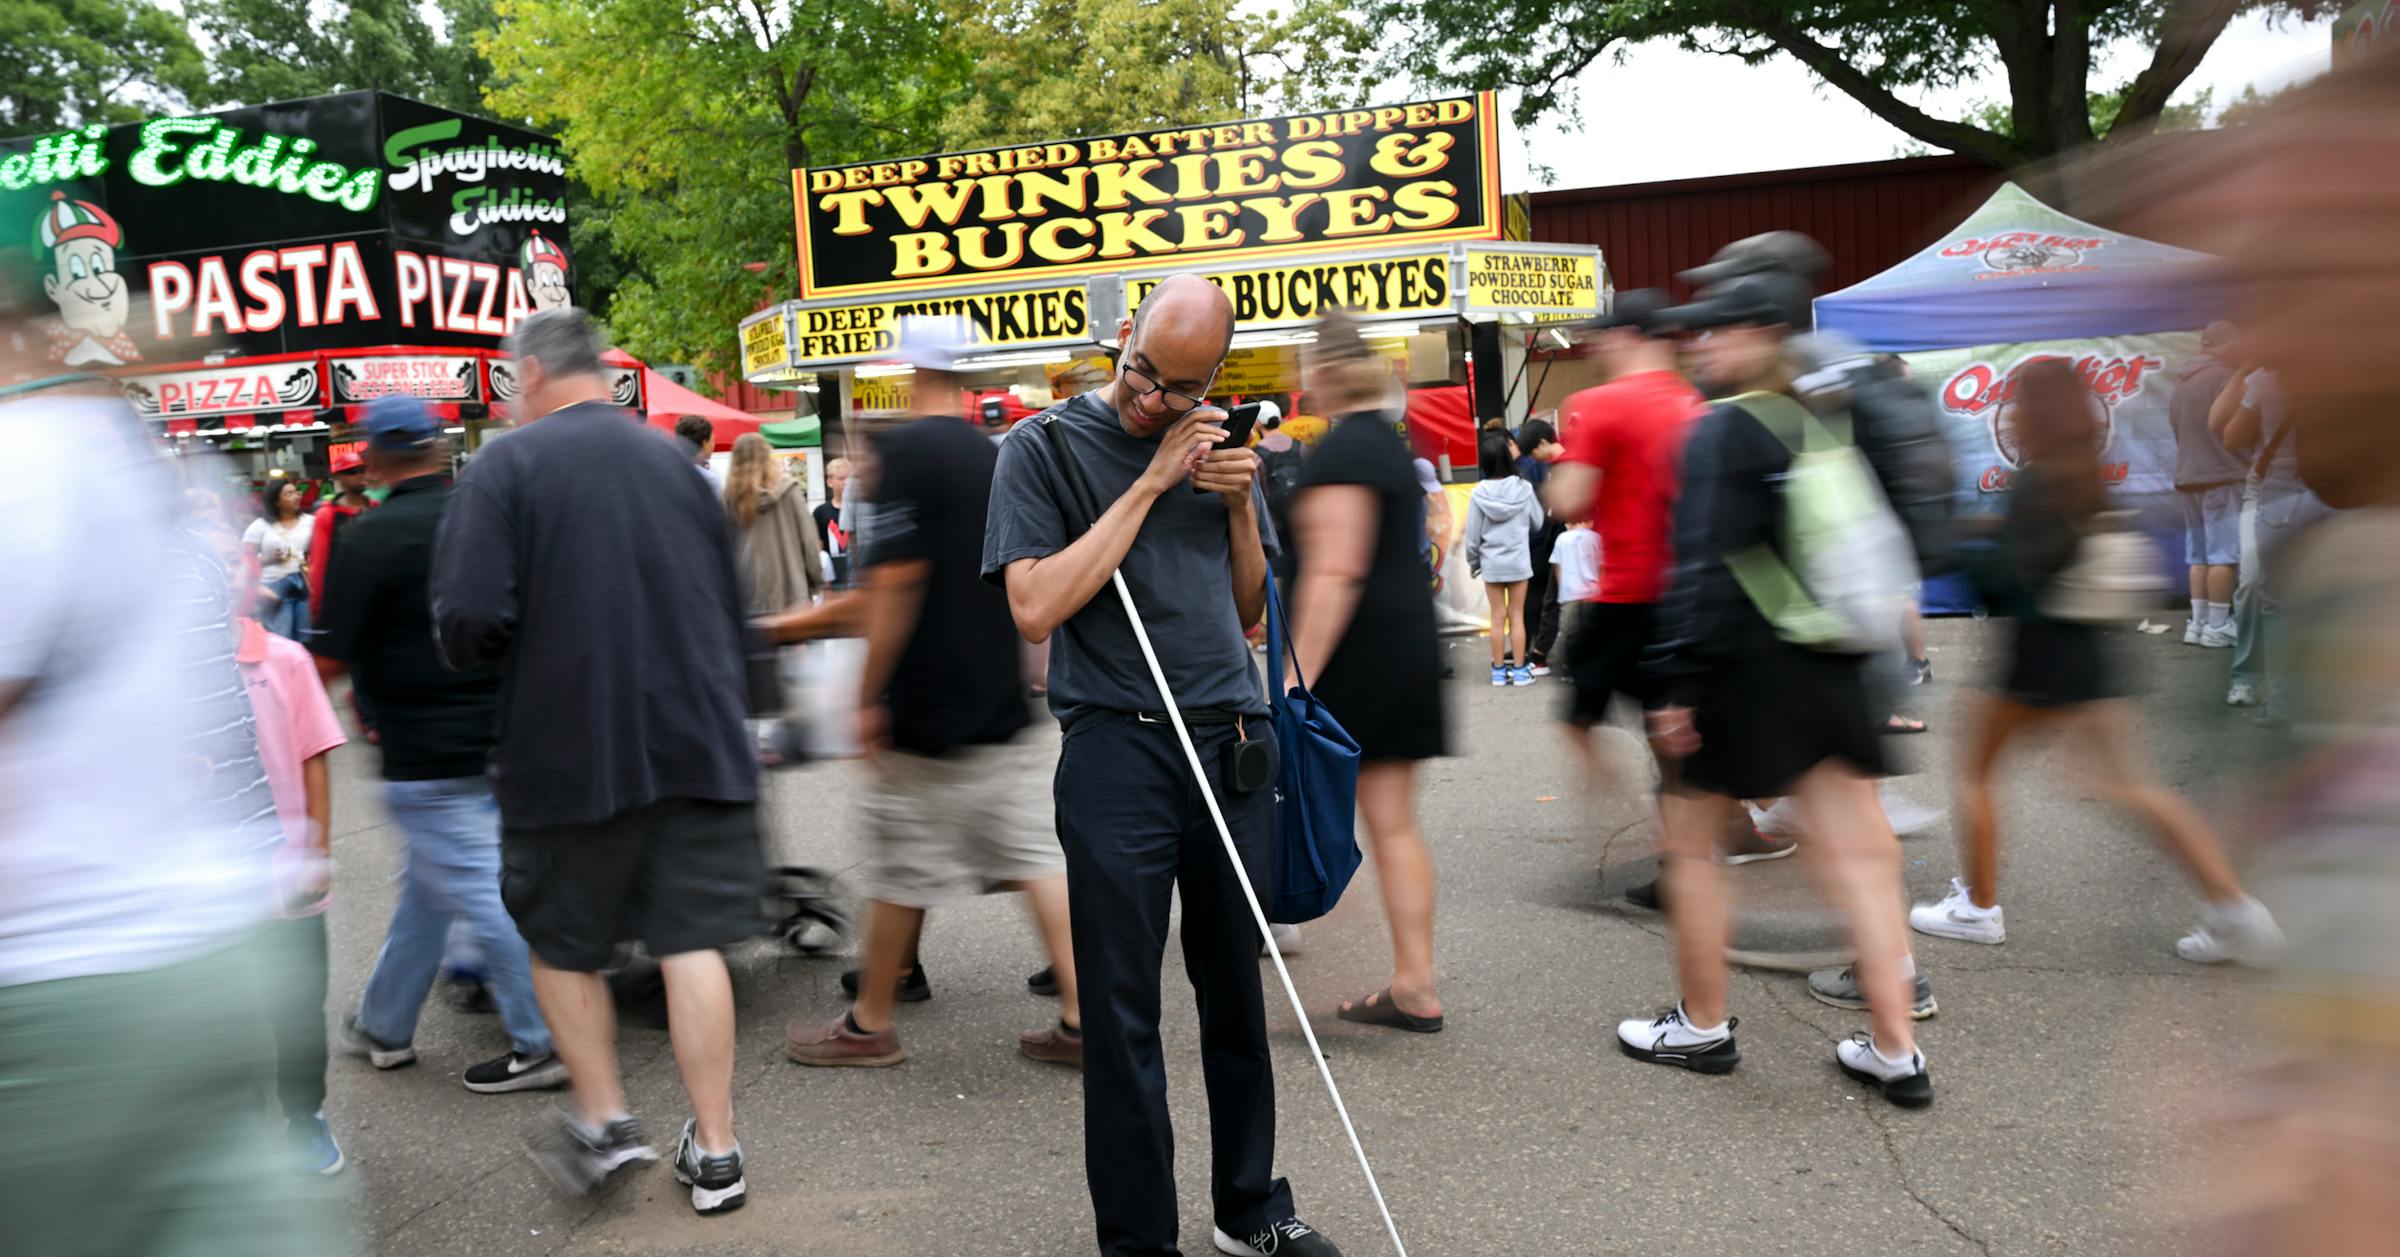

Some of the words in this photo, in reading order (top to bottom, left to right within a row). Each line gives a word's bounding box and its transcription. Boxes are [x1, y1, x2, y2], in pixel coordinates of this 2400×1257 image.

[128, 115, 382, 212] Eddies
[384, 118, 565, 193] Spaghetti
[811, 159, 928, 193] DEEP
[937, 143, 1081, 179] FRIED
[1088, 121, 1278, 162] BATTER
[1288, 99, 1476, 141] DIPPED
[819, 140, 1346, 235] TWINKIES
[1370, 131, 1455, 178] &
[450, 185, 566, 235] Eddies
[889, 180, 1460, 279] BUCKEYES
[1233, 257, 1446, 321] BUCKEYES
[1469, 272, 1545, 289] POWDERED
[1550, 273, 1594, 290] SUGAR
[1485, 255, 1578, 273] STRAWBERRY
[148, 241, 381, 340] PASTA
[395, 250, 536, 336] PIZZA
[1491, 289, 1574, 306] CHOCOLATE
[803, 330, 894, 357] FRIED
[808, 307, 884, 333] DEEP
[159, 375, 280, 413] PIZZA
[364, 362, 408, 379] SUPER
[411, 361, 449, 379] STICK
[861, 385, 912, 411] Ohio
